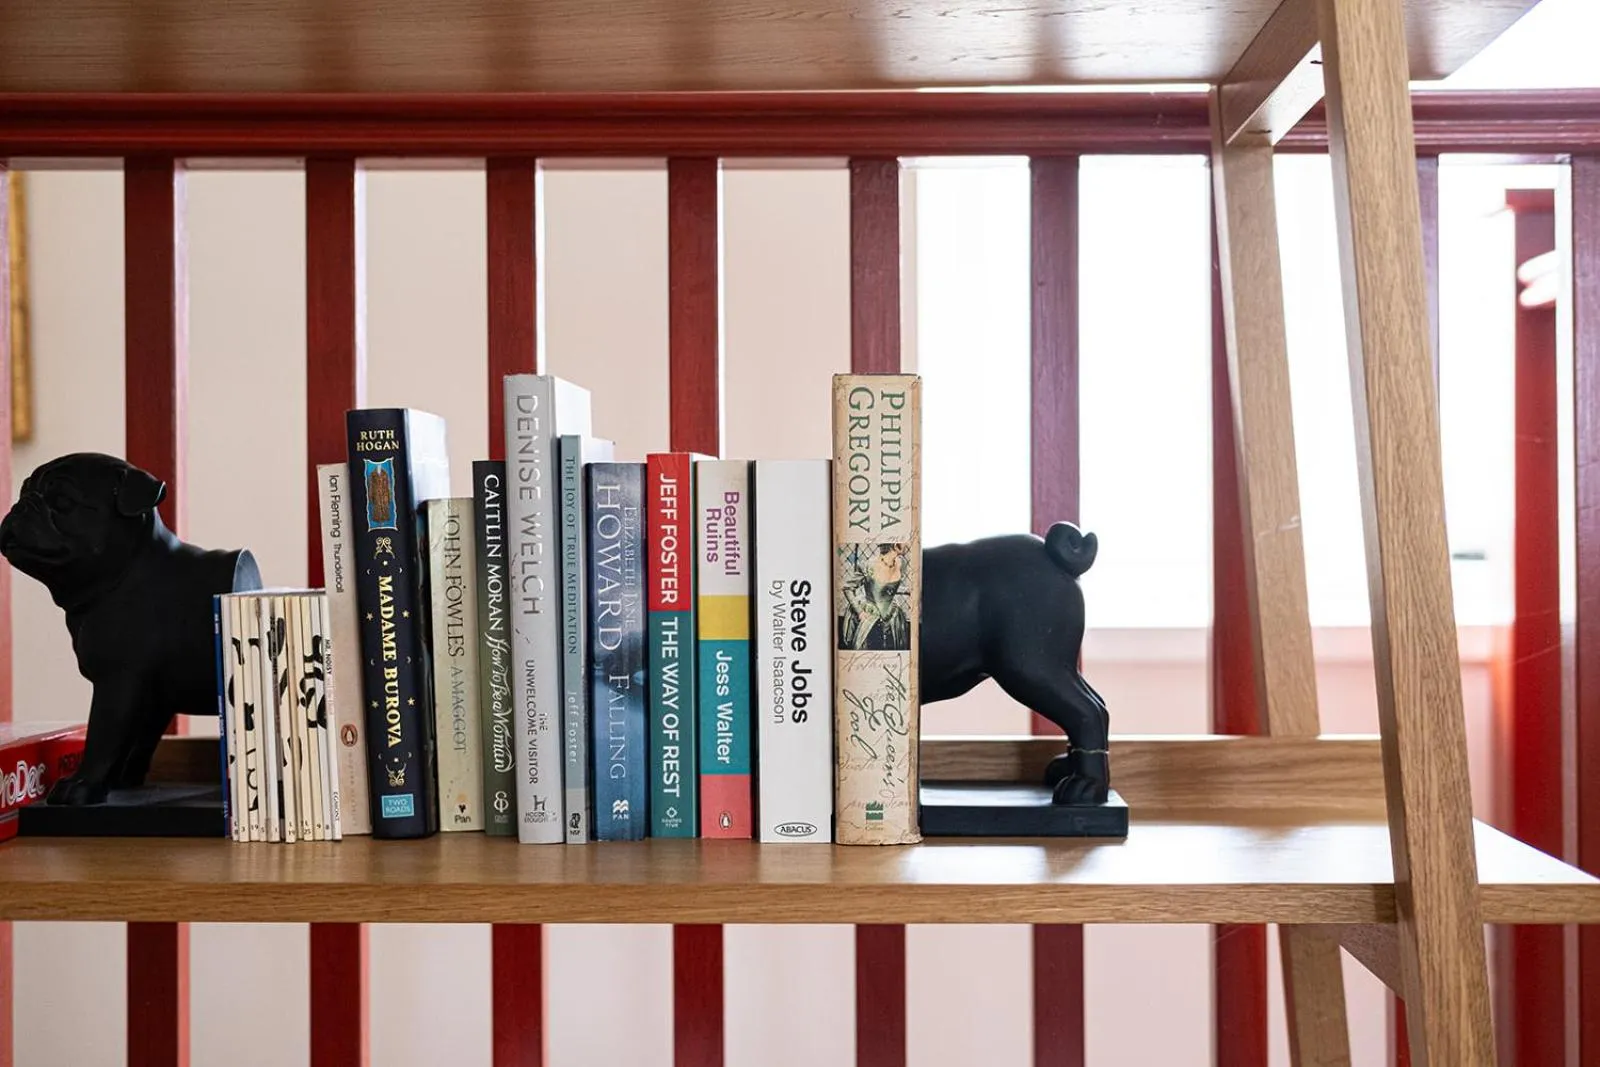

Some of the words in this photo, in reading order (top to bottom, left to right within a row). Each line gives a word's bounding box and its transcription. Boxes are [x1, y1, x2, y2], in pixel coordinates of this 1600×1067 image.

[356, 440, 400, 451] HOGAN
[360, 430, 394, 440] RUTH
[516, 395, 541, 500] DENISE
[848, 386, 875, 533] GREGORY
[880, 391, 905, 530] PHILIPPA
[329, 475, 339, 493] Ian
[564, 456, 576, 482] THE
[330, 494, 341, 543] Fleming
[484, 474, 502, 558] CAITLIN
[564, 486, 576, 509] JOY
[564, 513, 576, 533] OF
[660, 473, 677, 521] JEFF
[443, 514, 462, 569] JOHN
[566, 534, 577, 566] TRUE
[624, 507, 639, 588] ELIZABETH
[706, 508, 722, 563] Ruins
[724, 491, 740, 575] Beautiful
[333, 543, 344, 593] Thunderball
[520, 512, 544, 615] WELCH
[597, 484, 623, 651] HOWARD
[660, 525, 678, 604] FOSTER
[769, 580, 786, 598] by
[378, 575, 397, 661] MADAME
[446, 575, 465, 657] FOWLES
[487, 563, 503, 631] MORAN
[567, 573, 577, 654] MEDITATION
[622, 592, 639, 628] JANE
[790, 580, 811, 653] Steve
[485, 631, 510, 669] How
[661, 617, 678, 658] THE
[772, 603, 786, 652] Walter
[490, 683, 507, 702] Be
[525, 659, 537, 736] UNWELCOME
[661, 662, 679, 710] WAY
[716, 650, 732, 697] Jess
[772, 657, 786, 724] Isaacson
[791, 660, 812, 724] Jobs
[383, 667, 402, 748] BUROVA
[451, 680, 468, 753] MAGGOT
[567, 691, 580, 719] Jeff
[608, 674, 630, 780] FALLING
[662, 713, 679, 741] OF
[843, 689, 880, 760] Fool
[493, 708, 515, 773] Woman
[568, 723, 579, 764] Foster
[717, 702, 734, 764] Walter
[527, 738, 539, 785] VISITOR
[663, 745, 680, 798] REST
[388, 799, 408, 807] TWO
[454, 814, 471, 824] Pan
[780, 825, 812, 834] ABACUS
